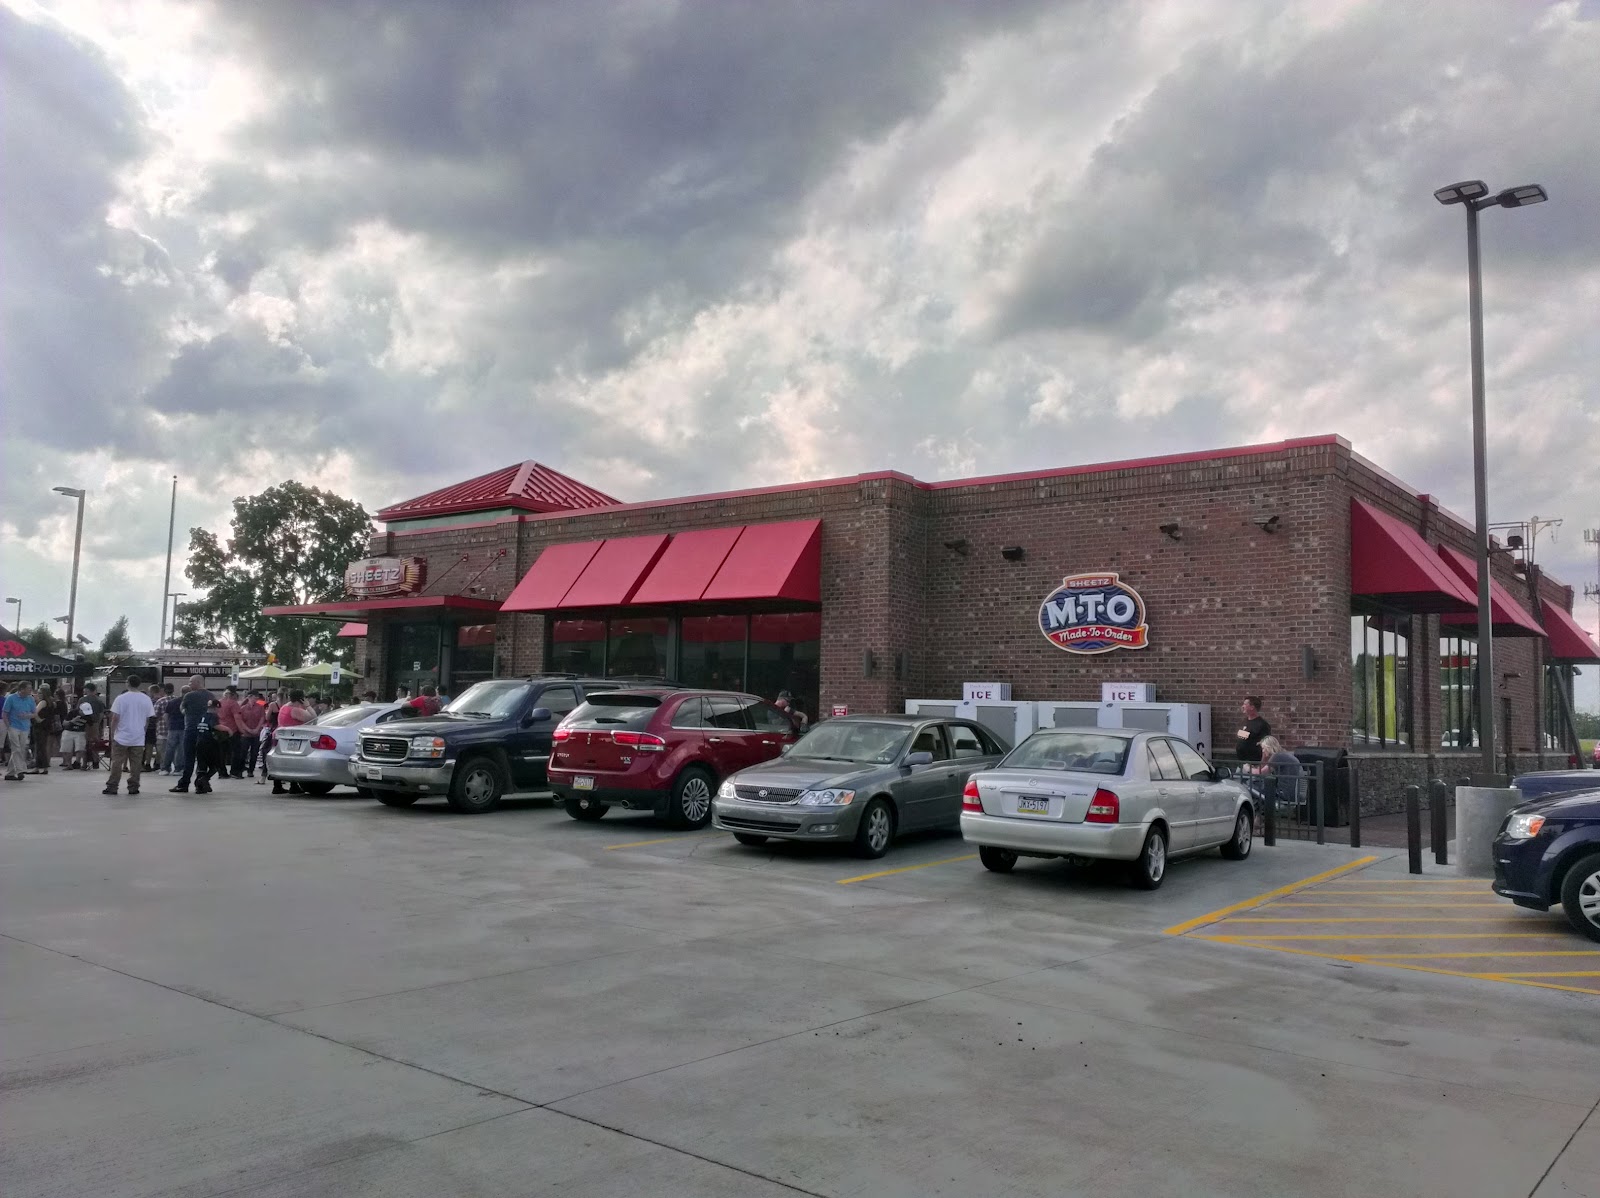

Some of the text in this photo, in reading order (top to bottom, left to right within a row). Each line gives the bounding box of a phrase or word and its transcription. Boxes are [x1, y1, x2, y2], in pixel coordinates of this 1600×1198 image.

[350, 568, 400, 584] SHEETZ
[1069, 578, 1110, 587] SHEETZ
[0, 662, 74, 674] HeartRADIO
[190, 667, 207, 675] MOON
[208, 667, 221, 675] RUN
[971, 691, 992, 699] ICE
[1112, 692, 1135, 700] ICE
